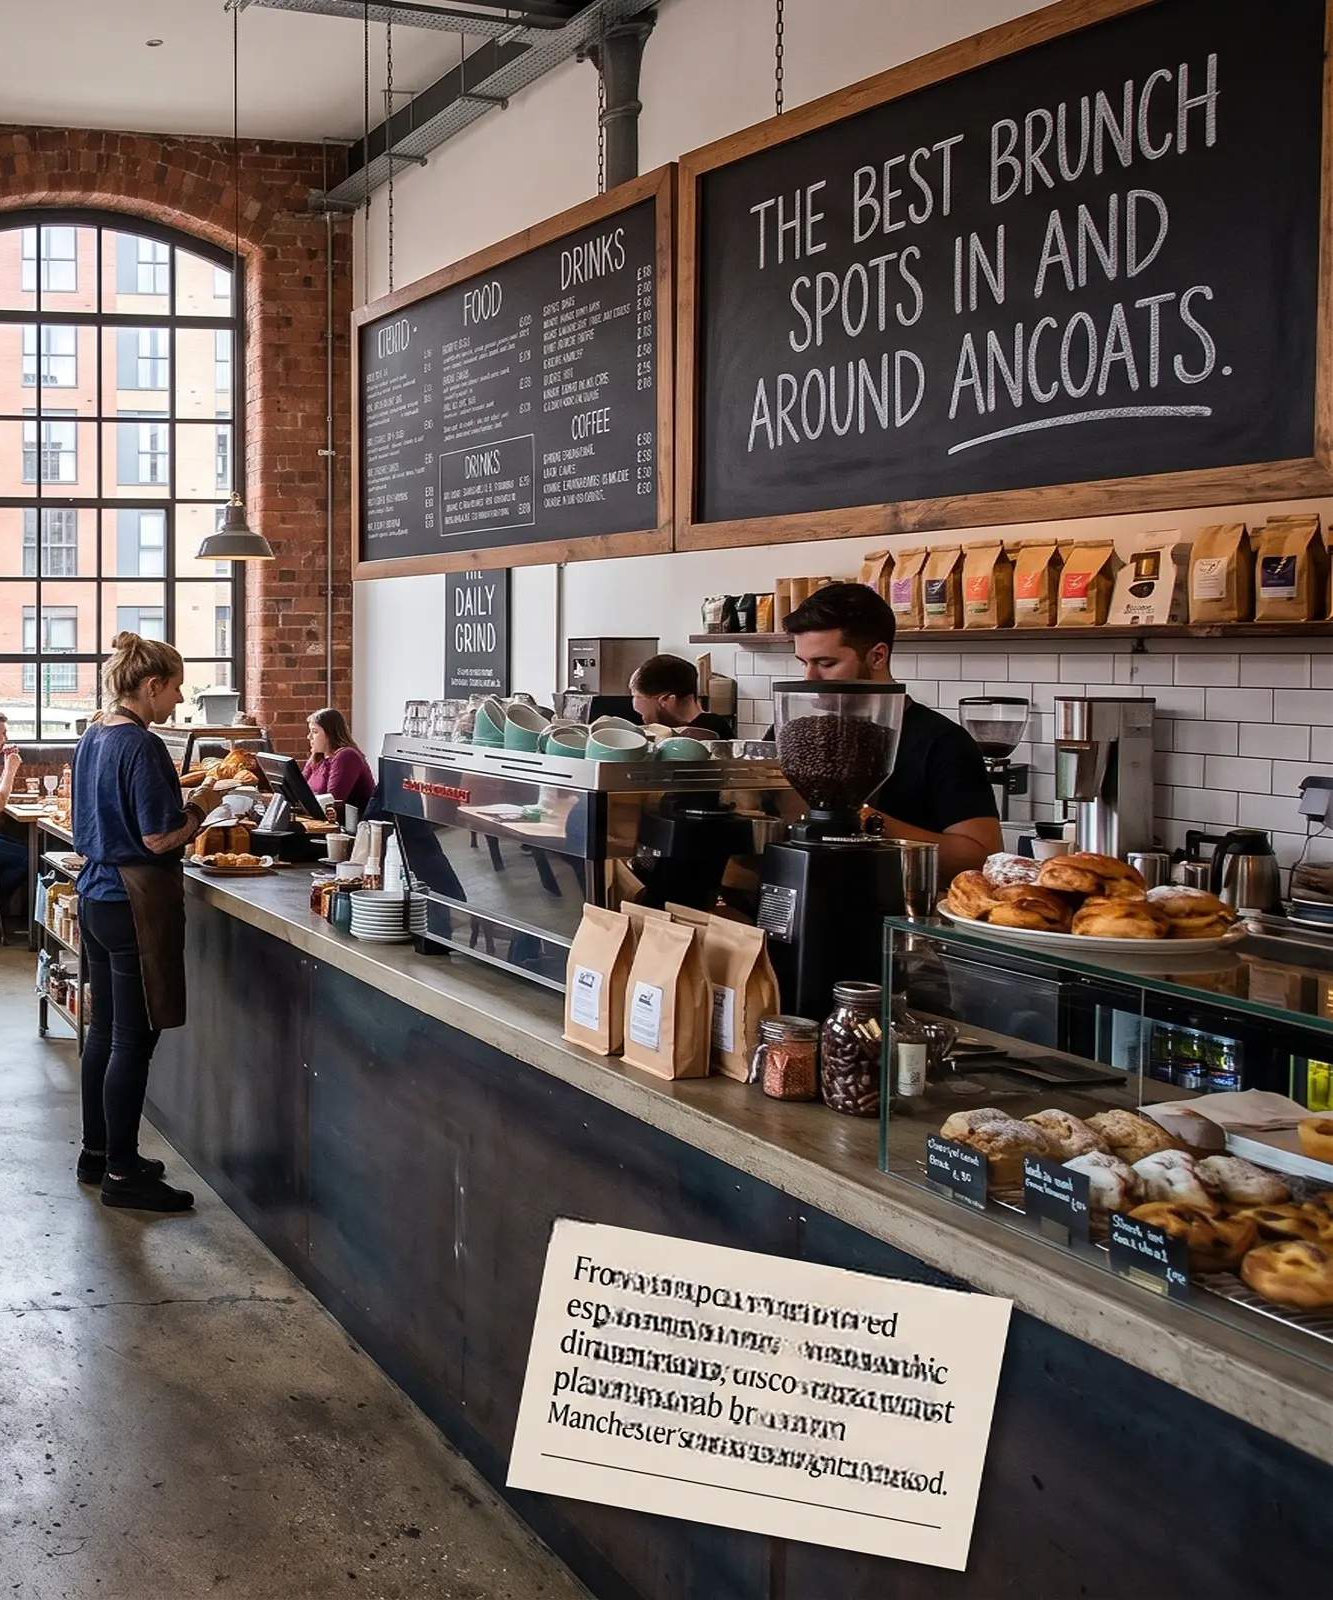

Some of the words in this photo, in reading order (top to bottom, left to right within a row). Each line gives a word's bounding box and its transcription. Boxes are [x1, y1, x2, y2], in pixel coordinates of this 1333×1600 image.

[750, 179, 827, 269] THE
[852, 134, 965, 243] BEST
[990, 53, 1223, 204] BRUNCH
[560, 227, 625, 291] DRINKS
[789, 246, 925, 353] SPOTS
[954, 224, 1005, 313] IN
[1034, 189, 1170, 298] AND
[463, 281, 503, 327] FOOD
[747, 349, 926, 452] AROUND
[948, 285, 1233, 419] ANCOATS.
[571, 407, 612, 441] COFFEE
[463, 449, 501, 480] DRINKS
[454, 583, 496, 618] DAILY
[455, 622, 497, 653] GRIND
